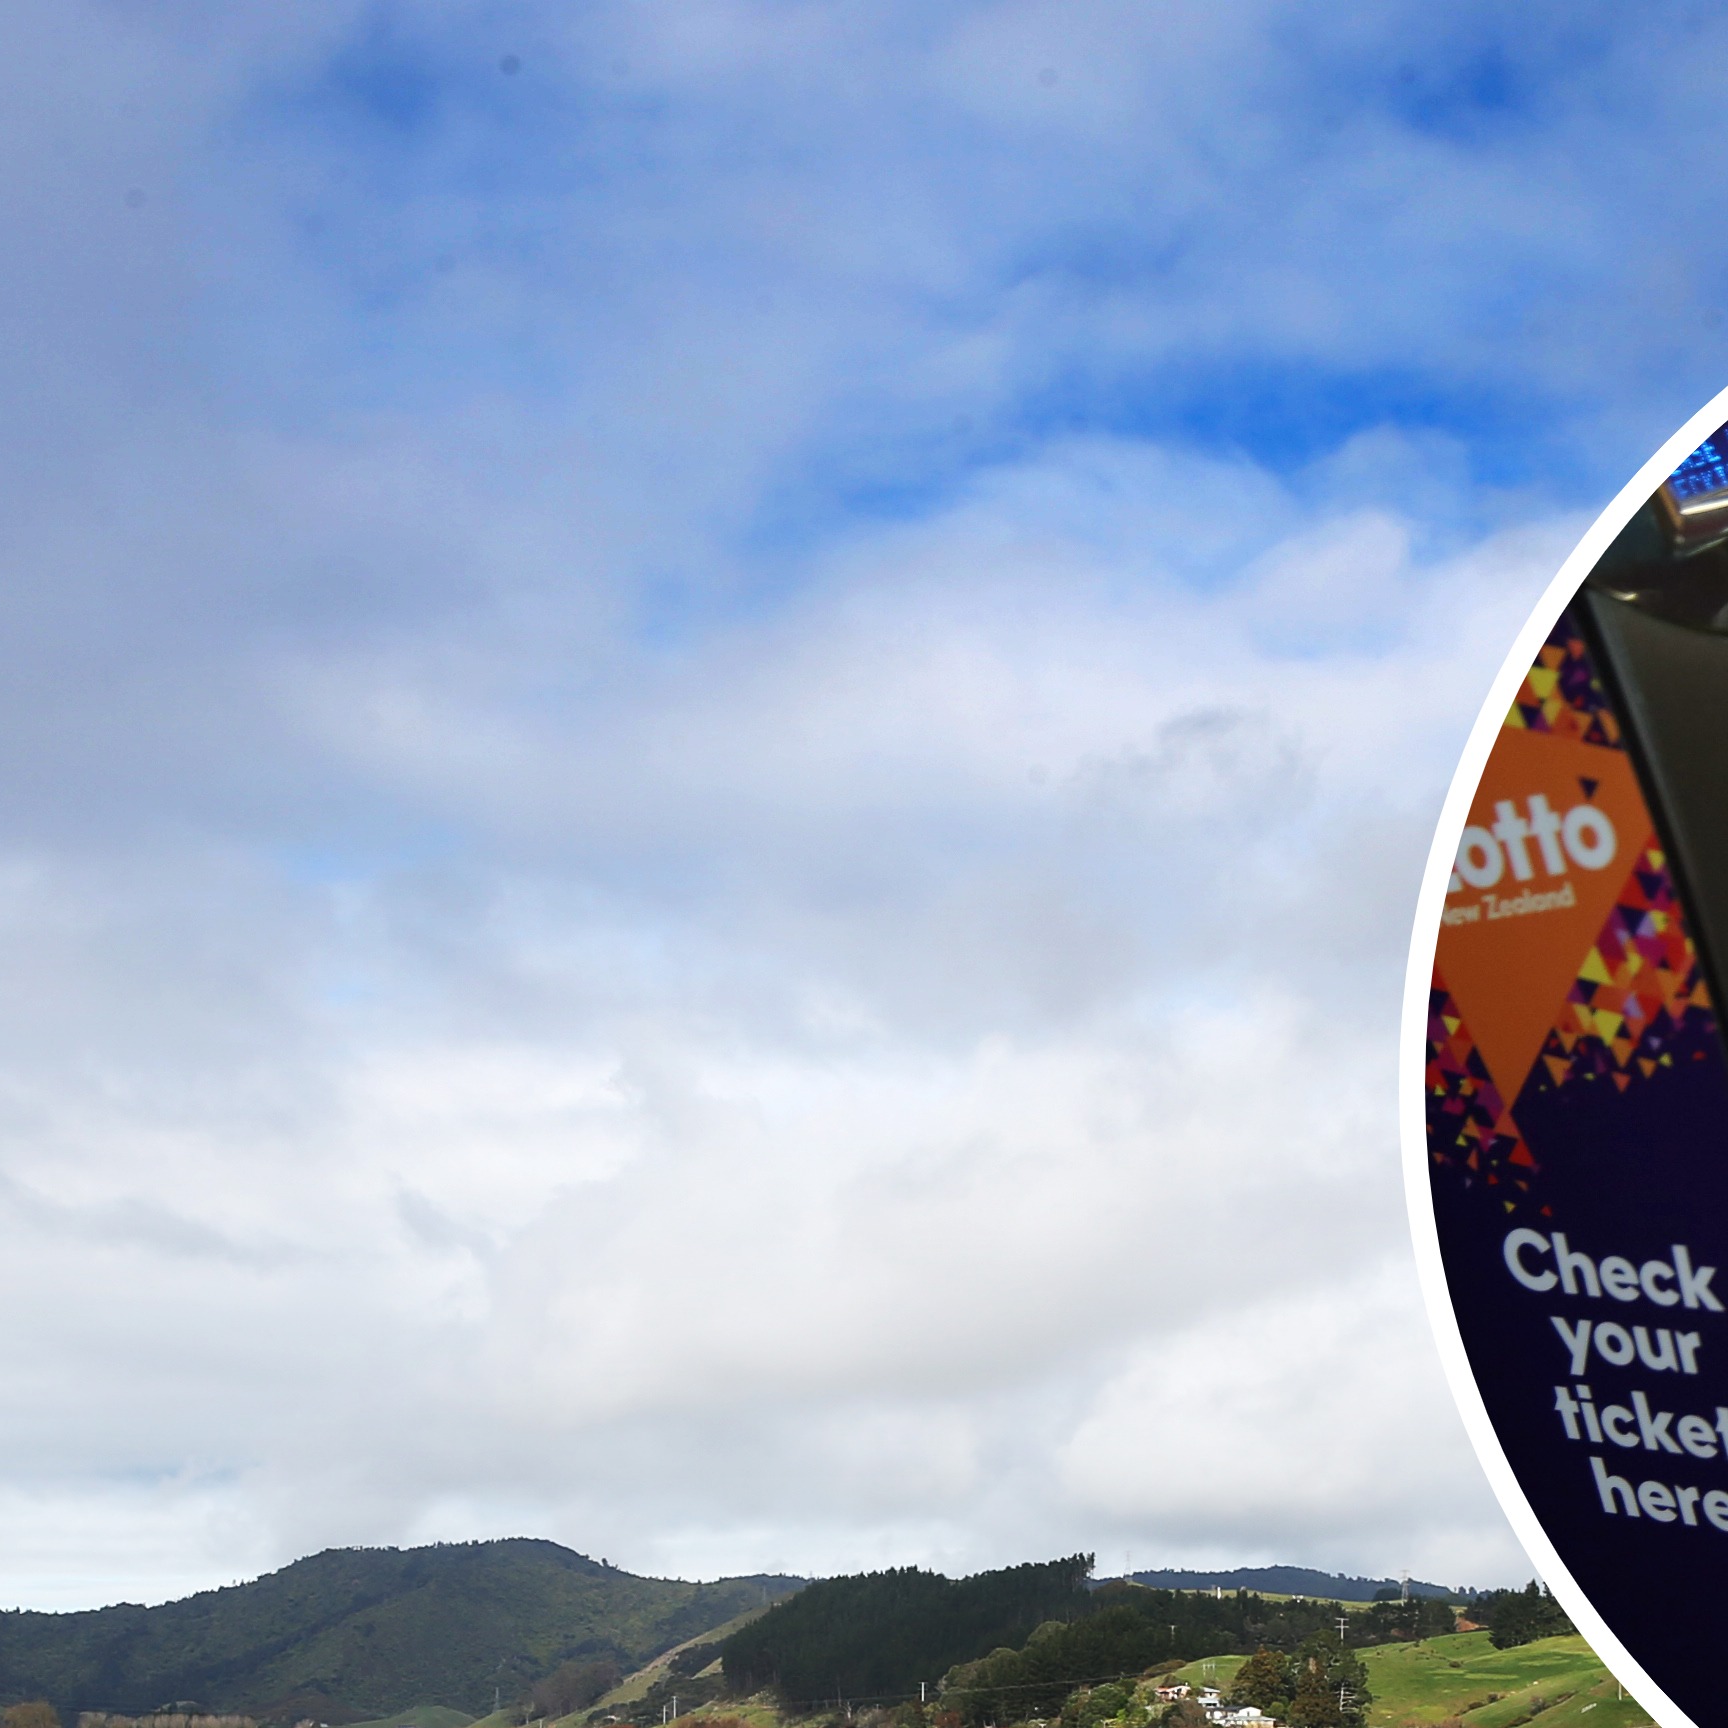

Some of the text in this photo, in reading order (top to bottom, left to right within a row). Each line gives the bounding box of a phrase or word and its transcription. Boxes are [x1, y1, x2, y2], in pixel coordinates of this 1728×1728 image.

[1446, 793, 1617, 893] otto
[1442, 881, 1576, 926] ew Zealand
[1502, 1227, 1726, 1312] Check
[1549, 1315, 1702, 1376] your
